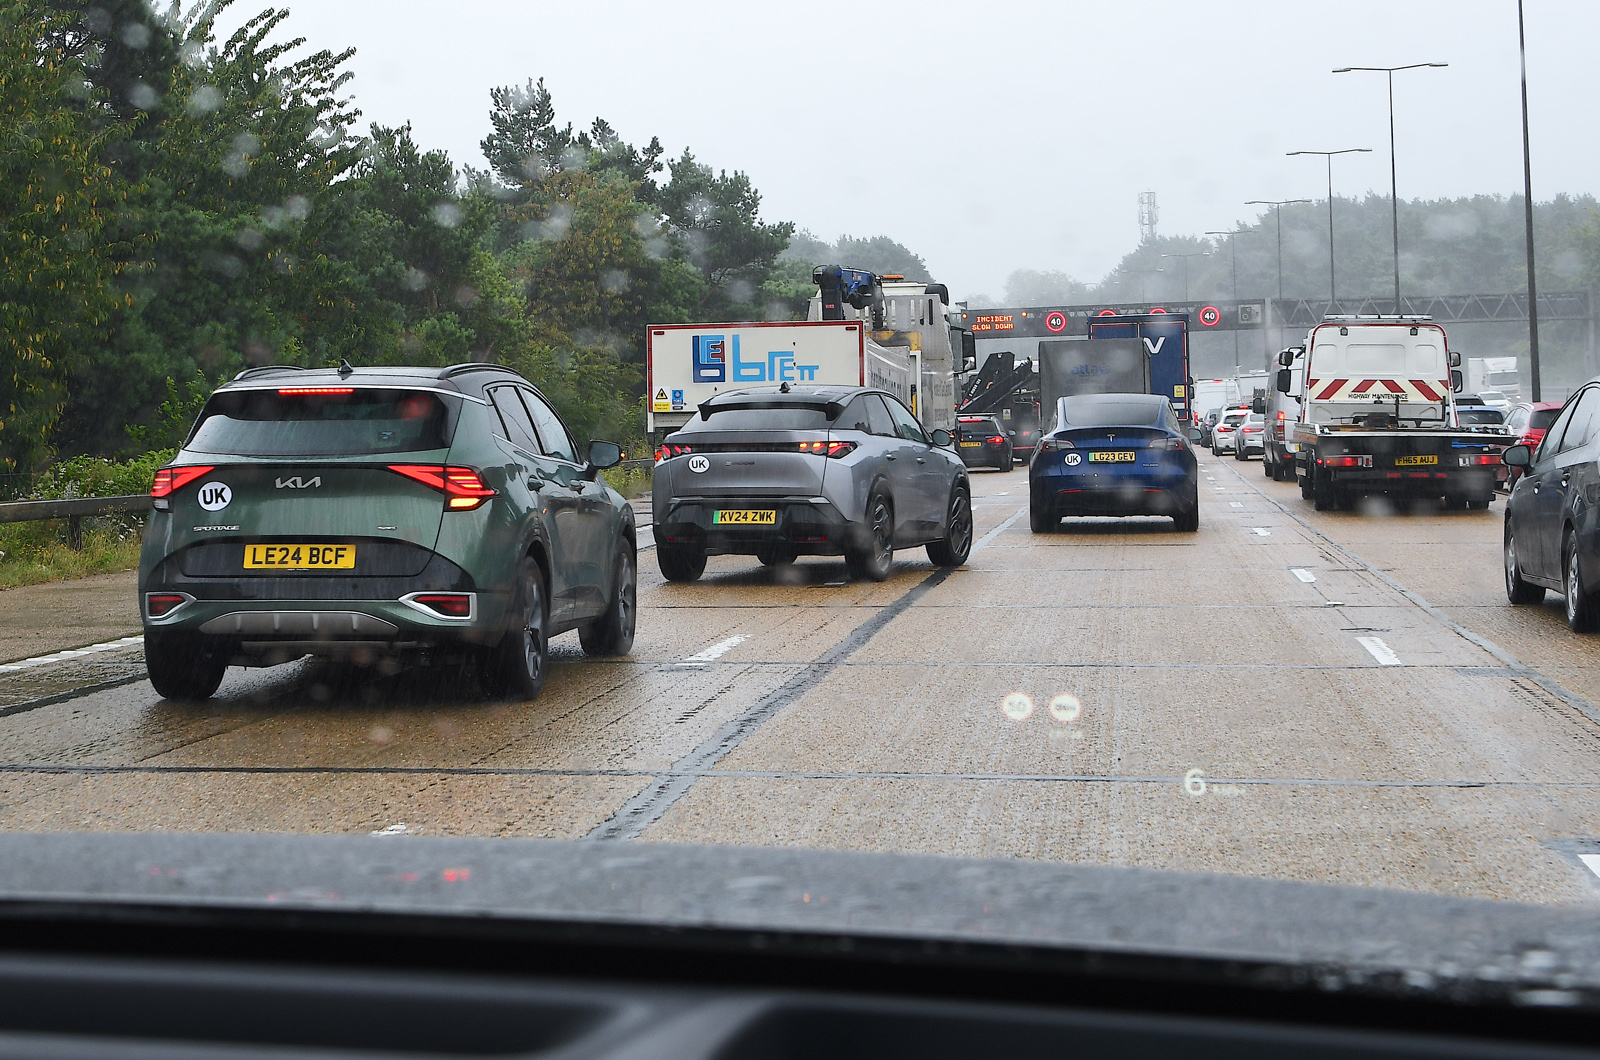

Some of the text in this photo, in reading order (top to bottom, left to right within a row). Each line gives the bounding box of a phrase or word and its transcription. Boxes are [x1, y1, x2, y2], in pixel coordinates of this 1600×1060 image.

[976, 315, 1013, 323] INCIDENT
[1204, 312, 1215, 320] 40
[1050, 318, 1061, 326] 40
[971, 323, 991, 331] SLOW
[1066, 455, 1079, 464] UK
[1093, 452, 1134, 461] LG23 GEV
[691, 460, 706, 469] UK
[275, 476, 321, 489] KIA
[202, 487, 227, 505] UK
[720, 511, 773, 522] KV24 ZWK
[251, 547, 347, 565] LE24 BCF
[1184, 768, 1206, 796] 6
